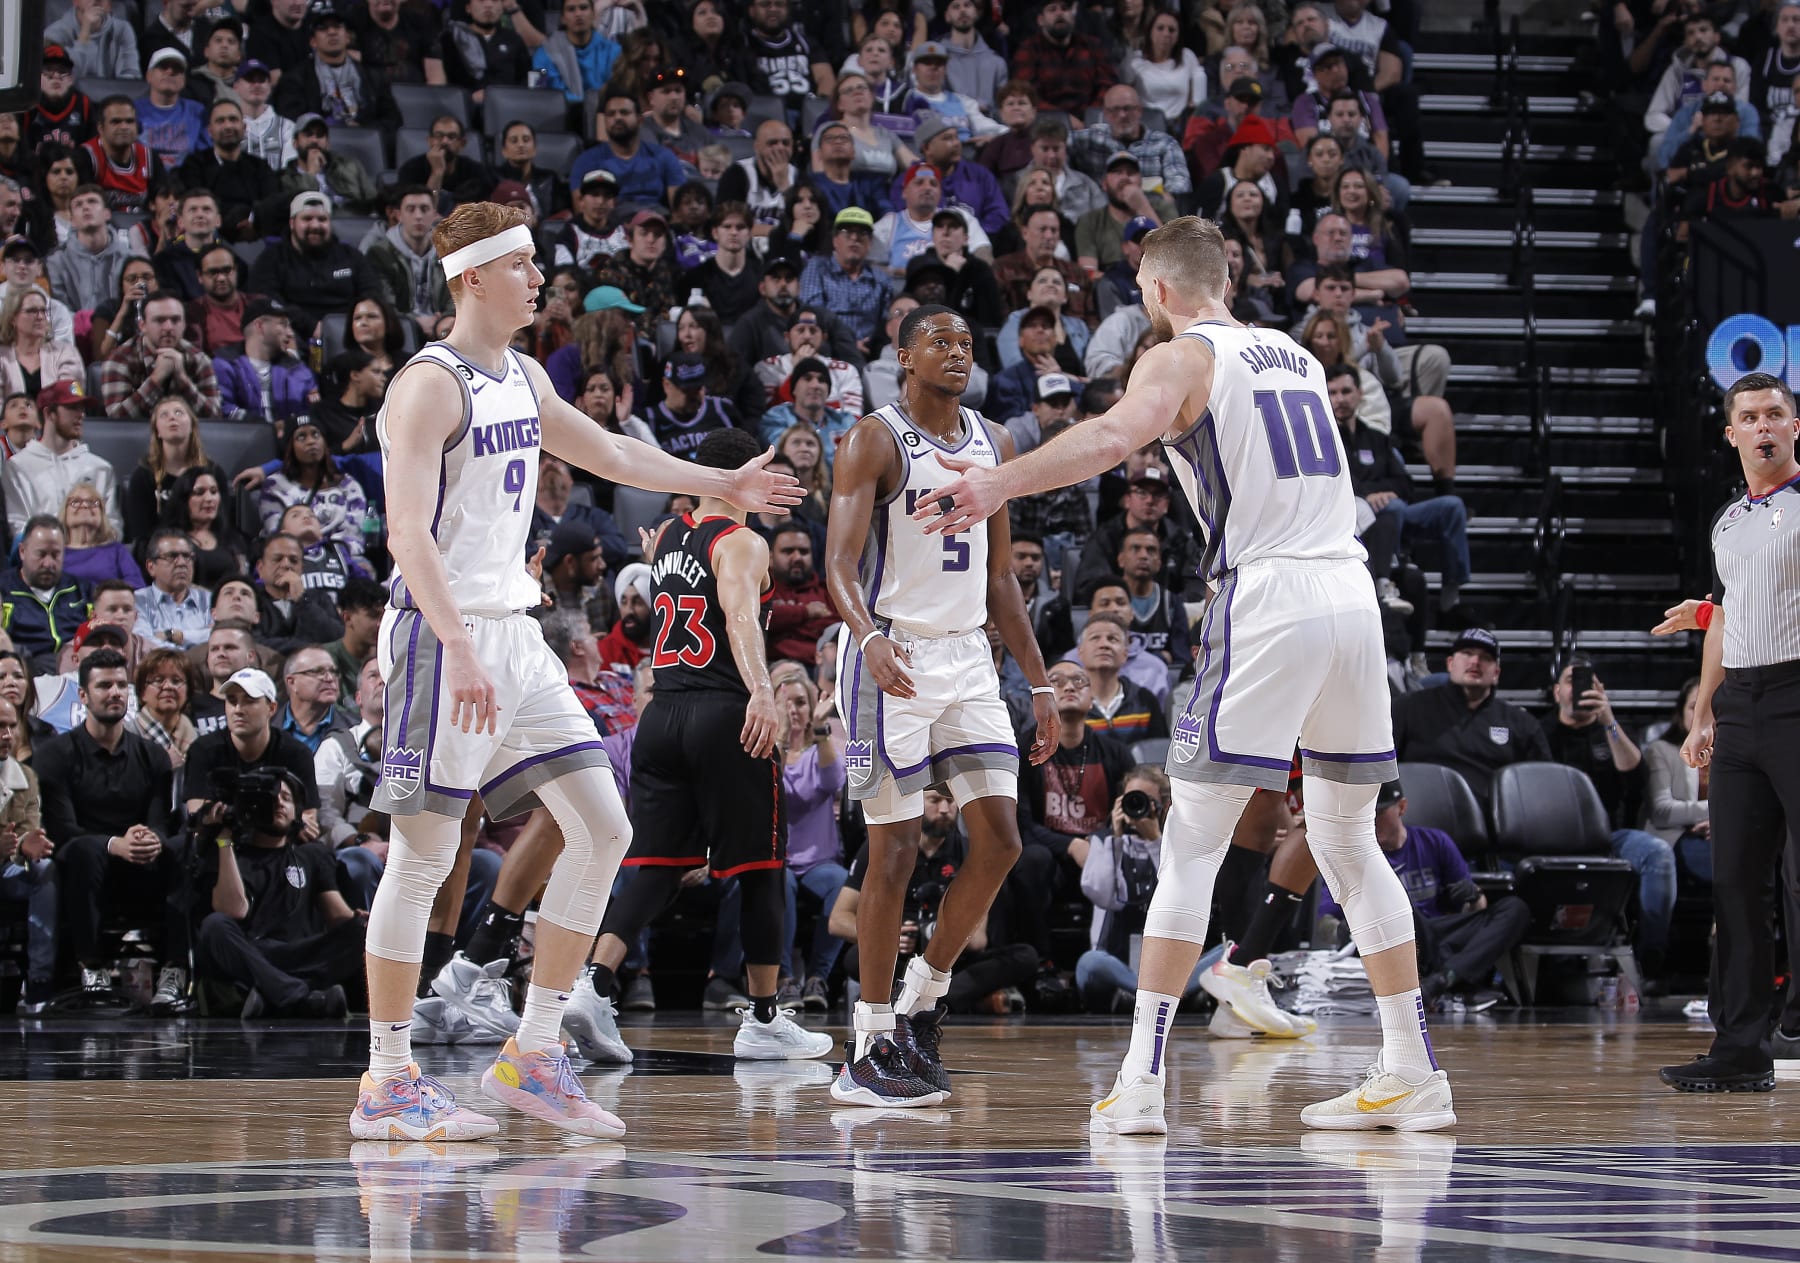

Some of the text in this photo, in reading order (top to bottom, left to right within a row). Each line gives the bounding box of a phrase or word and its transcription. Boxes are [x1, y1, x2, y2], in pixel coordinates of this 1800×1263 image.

[768, 69, 810, 95] 55
[1239, 344, 1308, 379] SABONIS
[472, 417, 539, 457] KINGS
[906, 432, 919, 447] 6
[1253, 389, 1341, 479] 10
[971, 449, 993, 457] dialpad
[503, 459, 526, 512] 9
[942, 528, 970, 572] 5
[651, 551, 707, 588] VANVLEET
[651, 592, 716, 668] 23
[1174, 729, 1199, 746] SAC
[385, 765, 420, 780] SAC
[1046, 791, 1086, 819] BIG
